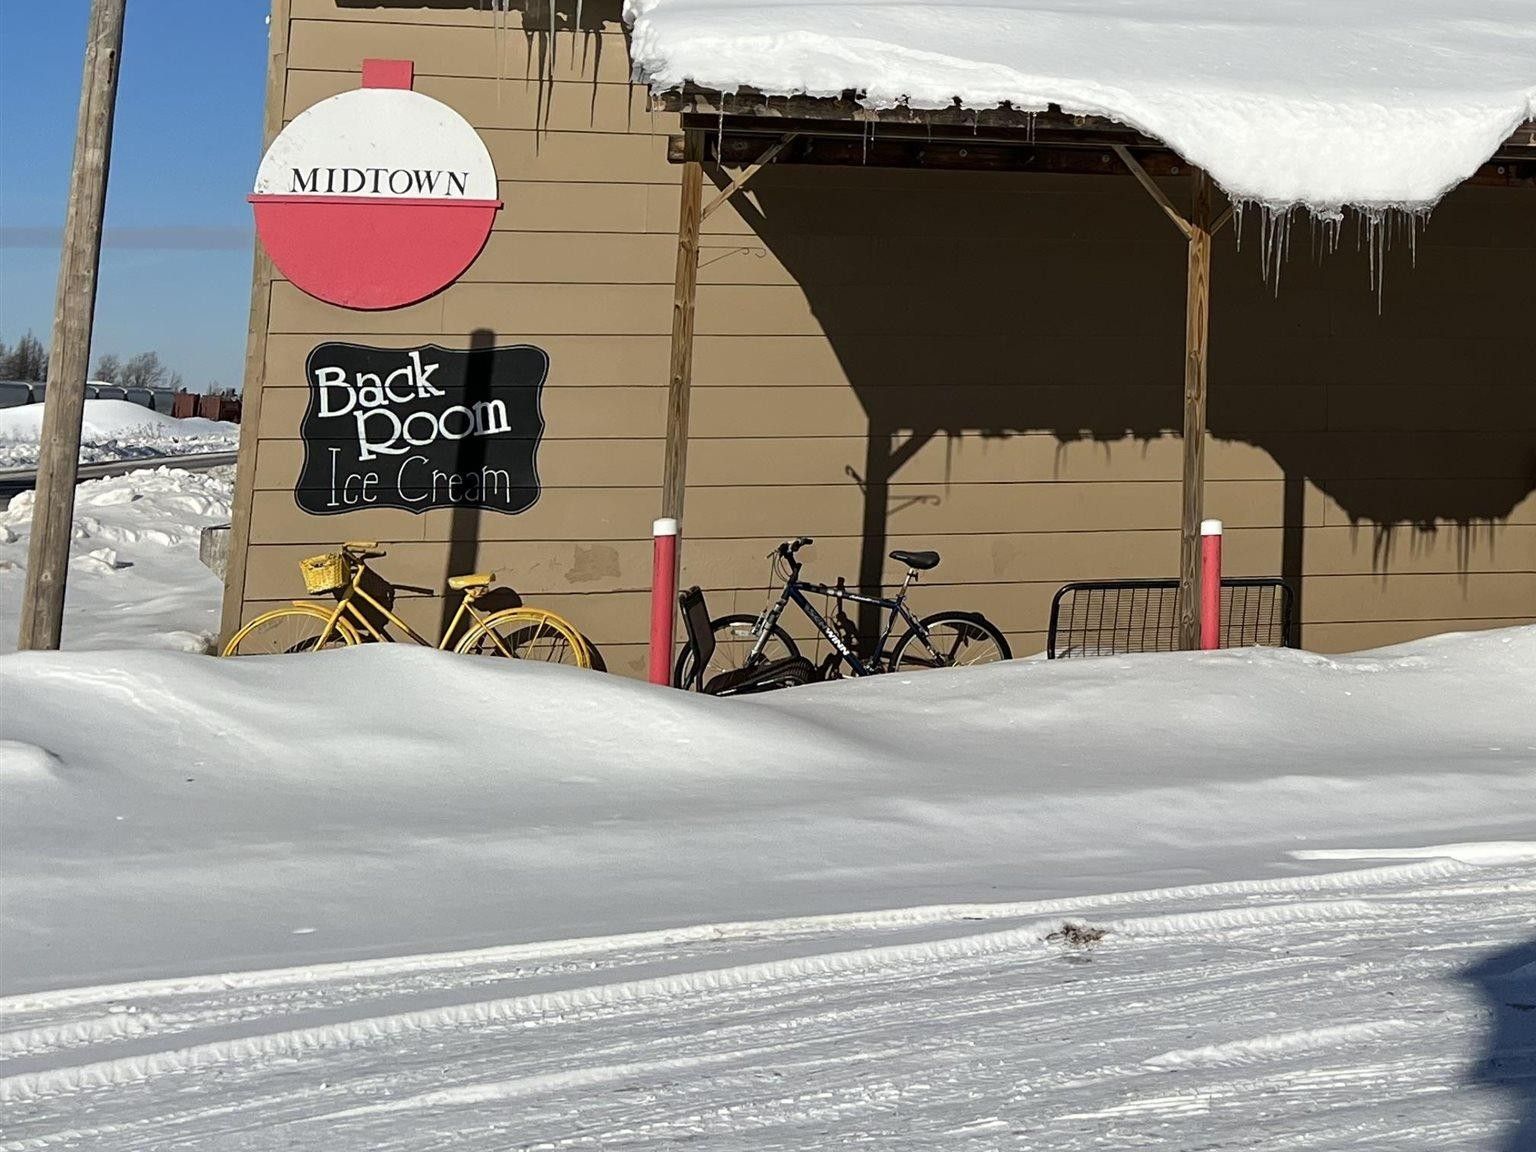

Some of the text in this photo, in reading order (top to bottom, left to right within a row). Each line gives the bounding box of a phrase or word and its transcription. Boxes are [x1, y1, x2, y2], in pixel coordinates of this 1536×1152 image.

[290, 167, 470, 195] MIDTOWN
[315, 350, 445, 418] Back
[353, 398, 512, 462] Room
[326, 447, 511, 507] Ice Cream
